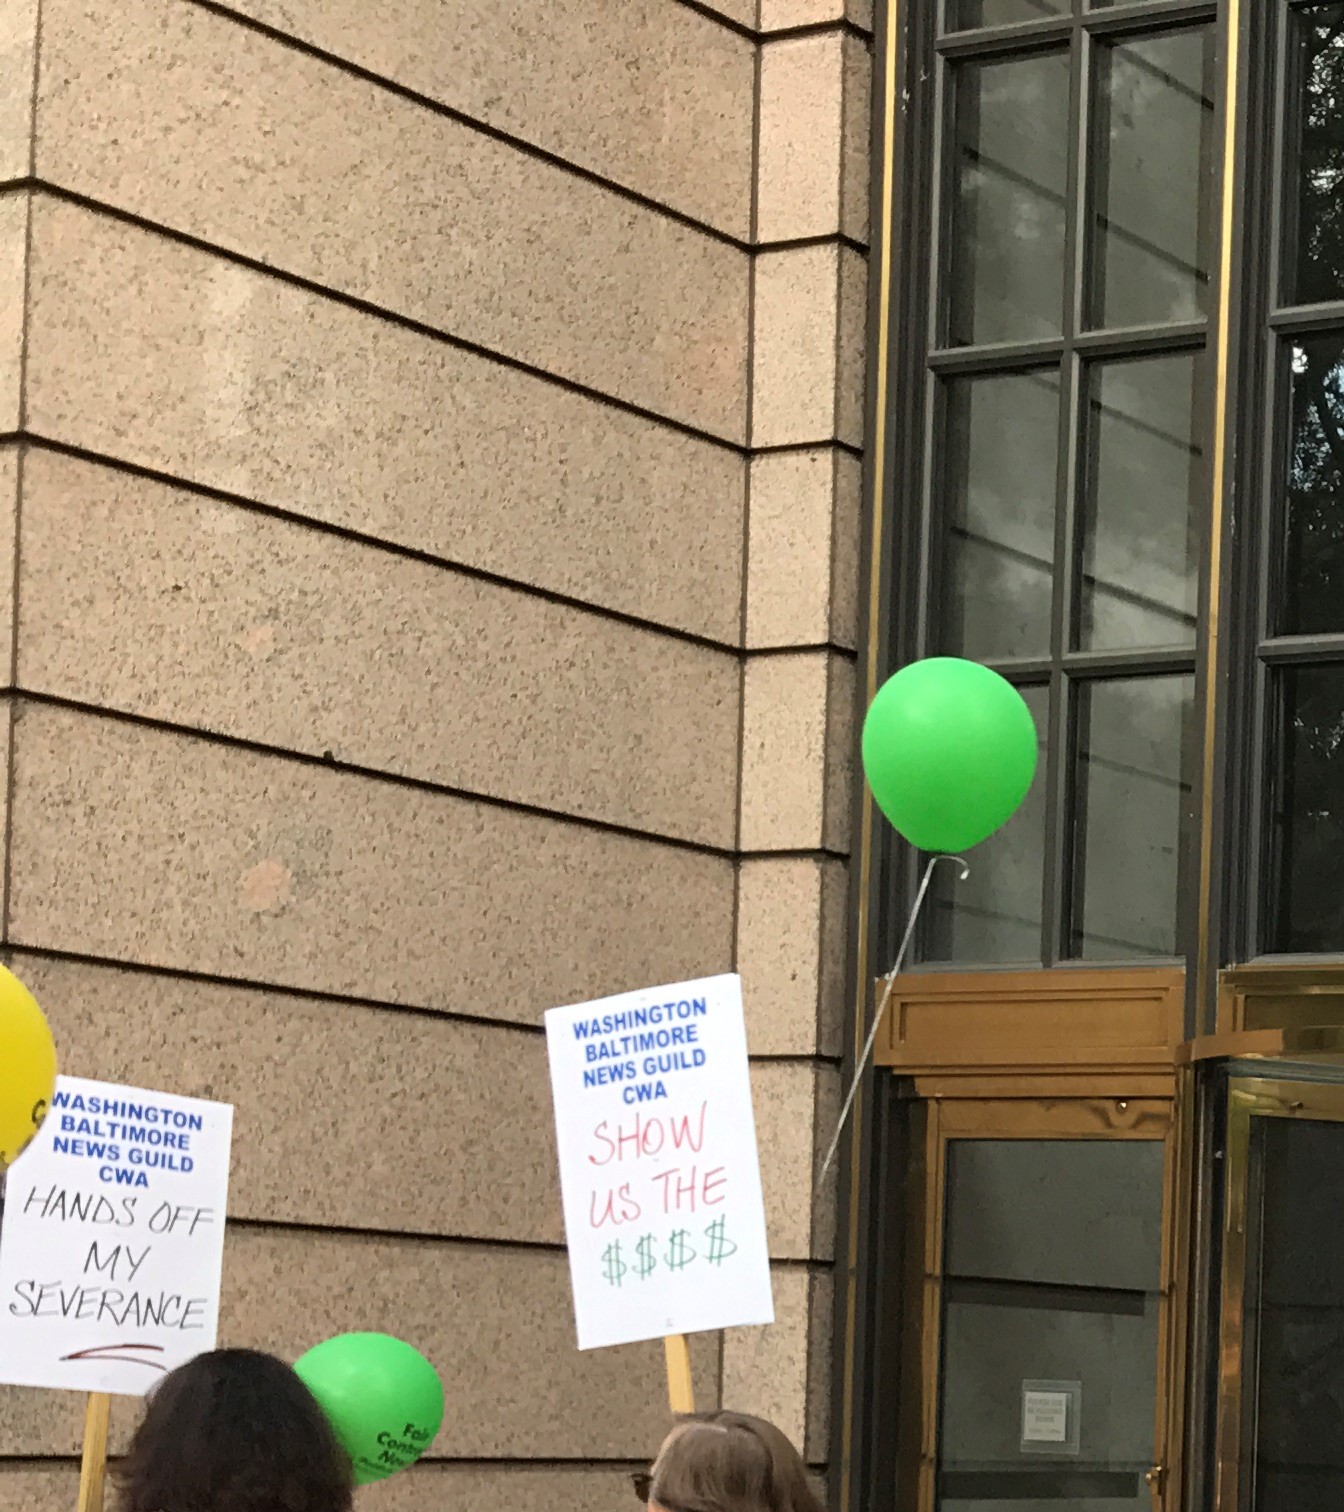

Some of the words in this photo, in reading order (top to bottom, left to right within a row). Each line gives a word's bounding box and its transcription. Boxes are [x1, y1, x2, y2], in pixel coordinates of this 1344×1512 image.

[573, 997, 707, 1040] WASHINGTON
[585, 1024, 699, 1063] BALTIMORE
[583, 1062, 637, 1088] NEWS
[643, 1048, 706, 1075] GUILD
[52, 1091, 203, 1131] WASHINGTON
[622, 1080, 668, 1105] CWA
[61, 1115, 190, 1151] BALTIMORE
[588, 1100, 707, 1166] SHOW
[53, 1136, 121, 1162] NEWS
[128, 1148, 194, 1173] GUILD
[99, 1166, 149, 1188] CWA
[589, 1182, 641, 1229] US
[651, 1165, 727, 1214] THE
[23, 1184, 137, 1229] HANDS
[149, 1200, 214, 1236] OFF
[84, 1240, 151, 1283] MY
[9, 1278, 208, 1330] SEVERANCE
